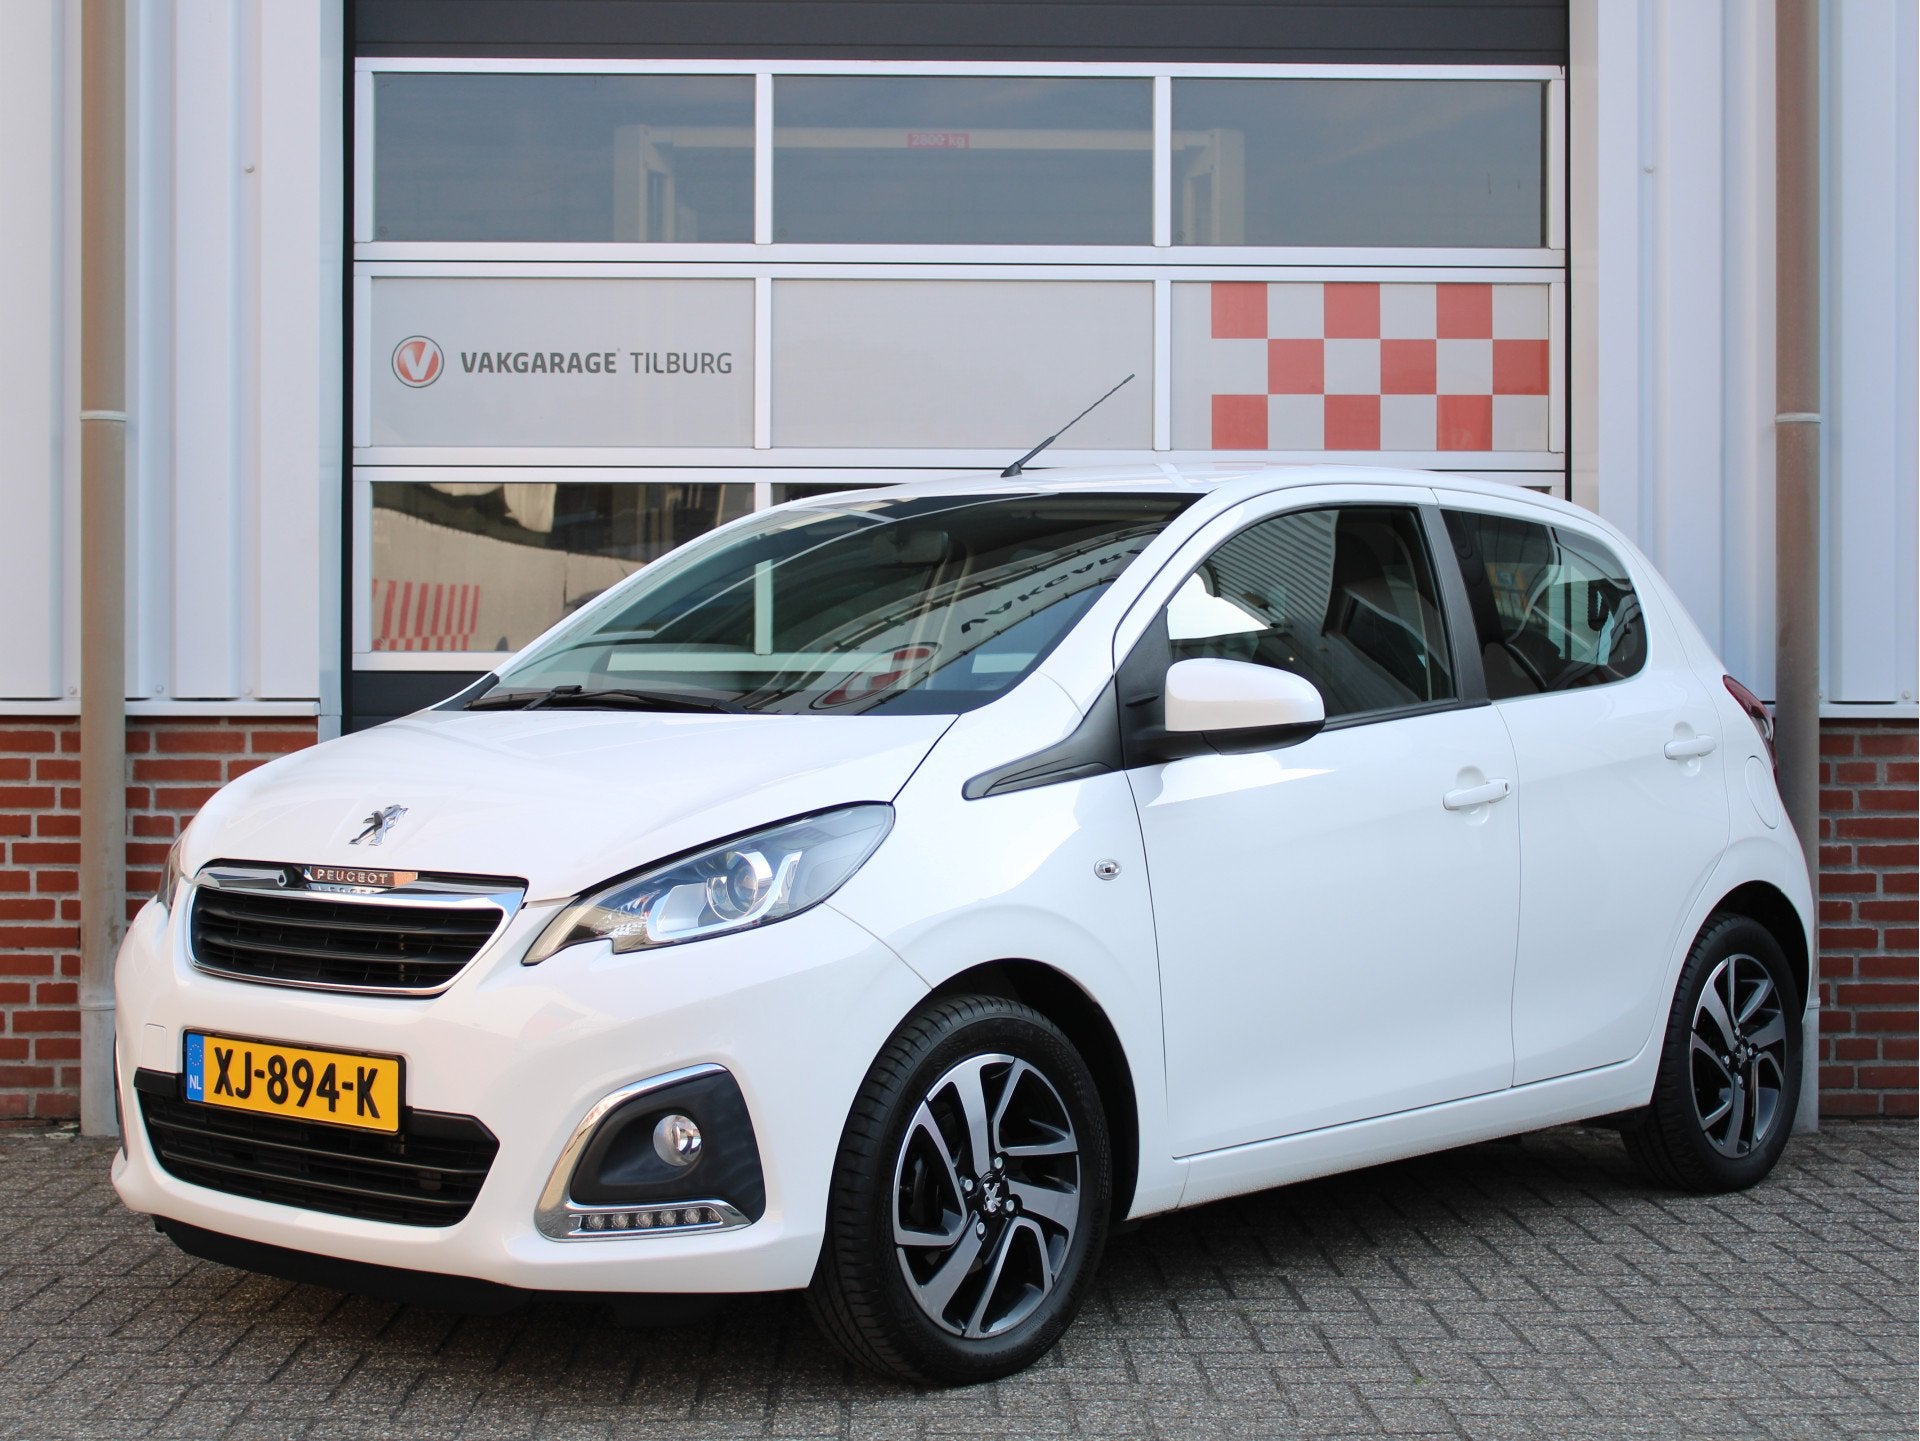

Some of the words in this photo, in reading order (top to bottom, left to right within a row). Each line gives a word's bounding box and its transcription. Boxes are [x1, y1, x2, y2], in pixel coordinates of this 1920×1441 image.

[912, 134, 944, 146] 2800
[948, 134, 966, 148] kg
[460, 352, 617, 374] VAKGARAGE
[630, 352, 732, 374] TILBURG
[317, 868, 388, 884] PEUGEOT
[189, 1074, 202, 1090] NL
[213, 1046, 381, 1119] XJ-894-K
